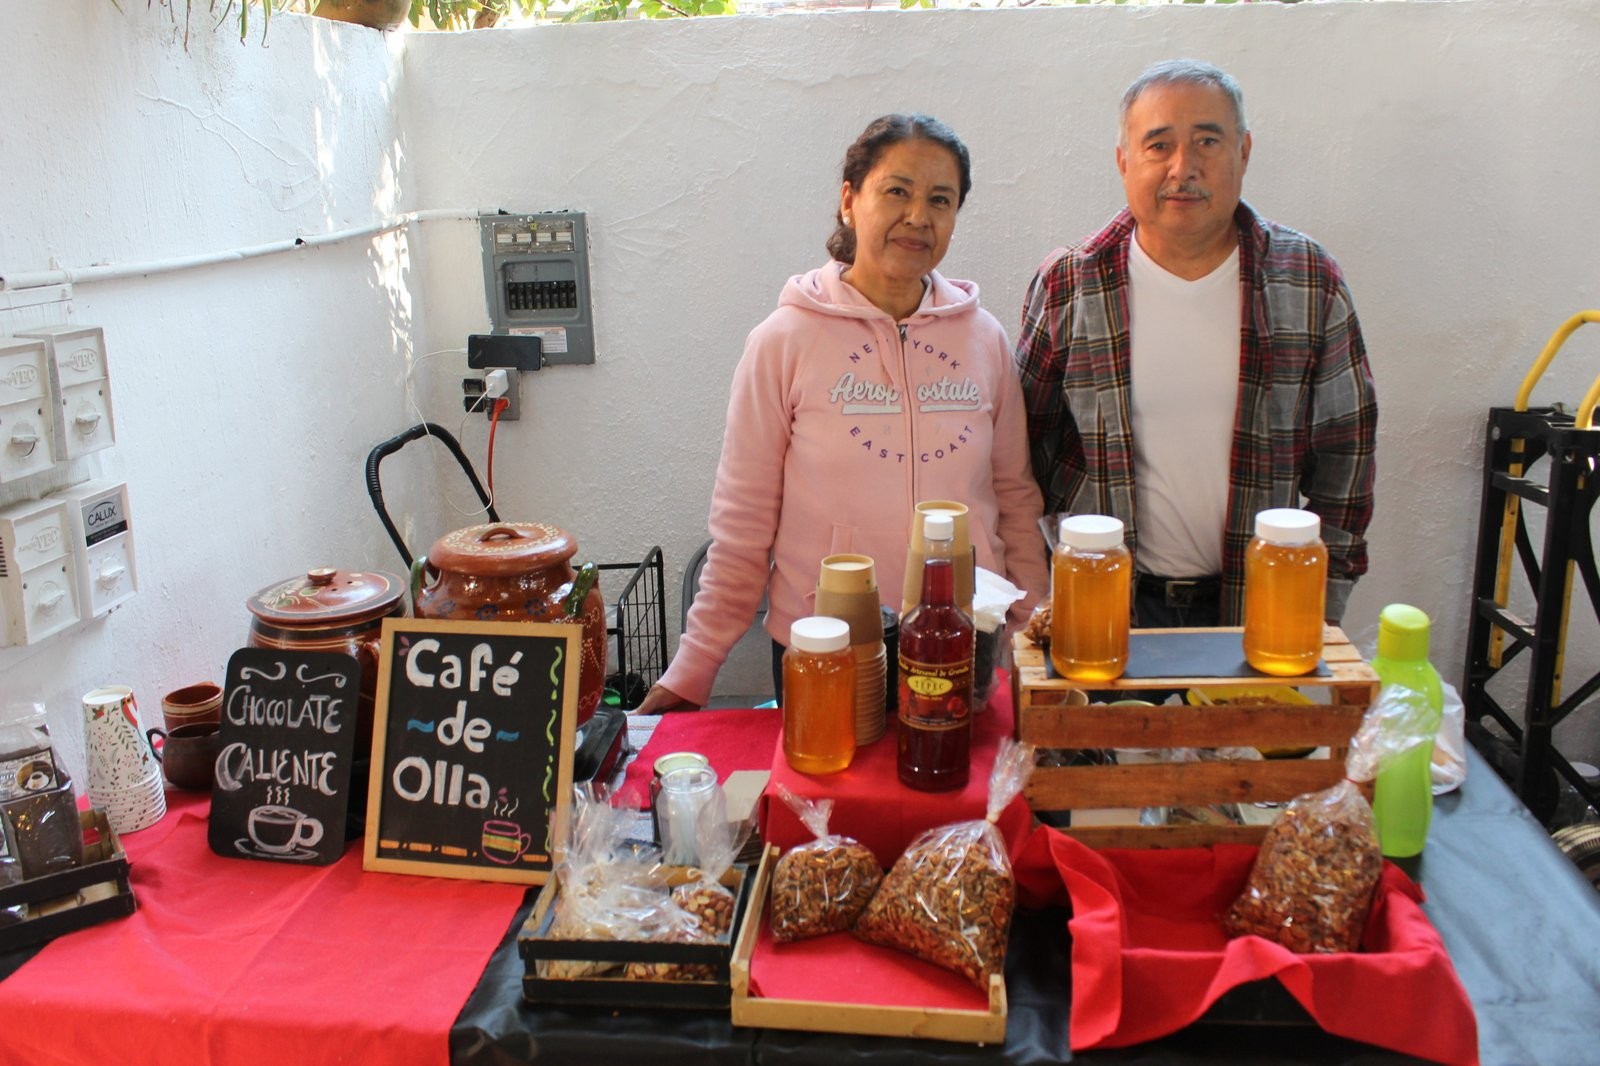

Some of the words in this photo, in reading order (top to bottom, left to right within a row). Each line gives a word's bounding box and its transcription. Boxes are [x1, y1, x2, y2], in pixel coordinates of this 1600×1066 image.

[913, 340, 960, 370] YORK
[849, 426, 905, 463] EAST
[920, 425, 973, 463] COAST
[87, 505, 117, 526] CALUX
[405, 638, 523, 696] Café
[227, 685, 343, 733] CHOCOLATE
[436, 700, 492, 753] de
[215, 742, 338, 796] CALIENTE
[392, 756, 491, 809] Olla
